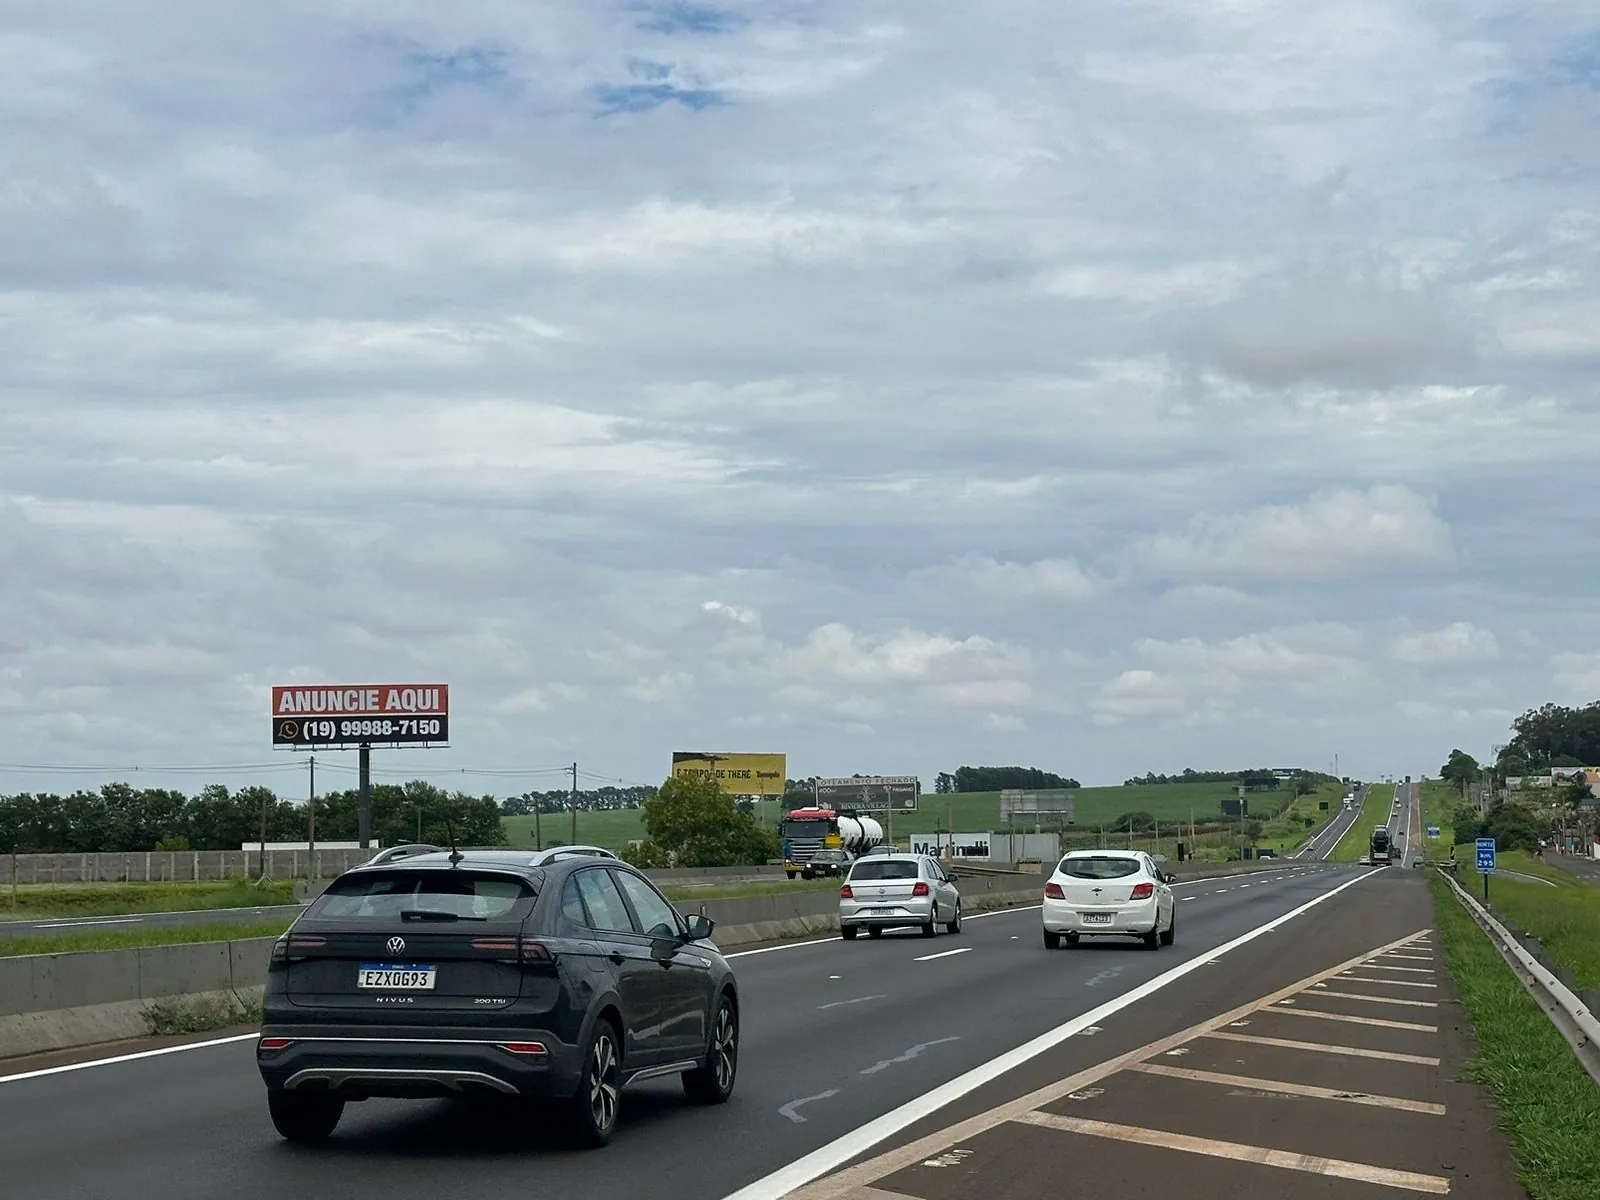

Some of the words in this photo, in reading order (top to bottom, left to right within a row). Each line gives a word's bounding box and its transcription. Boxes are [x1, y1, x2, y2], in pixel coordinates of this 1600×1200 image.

[278, 689, 380, 712] ANUNCIE
[385, 688, 439, 712] AQUI
[302, 720, 337, 740] (19)
[341, 719, 440, 737] 99988-7150
[866, 802, 892, 810] VILLAG
[1477, 859, 1494, 867] 295
